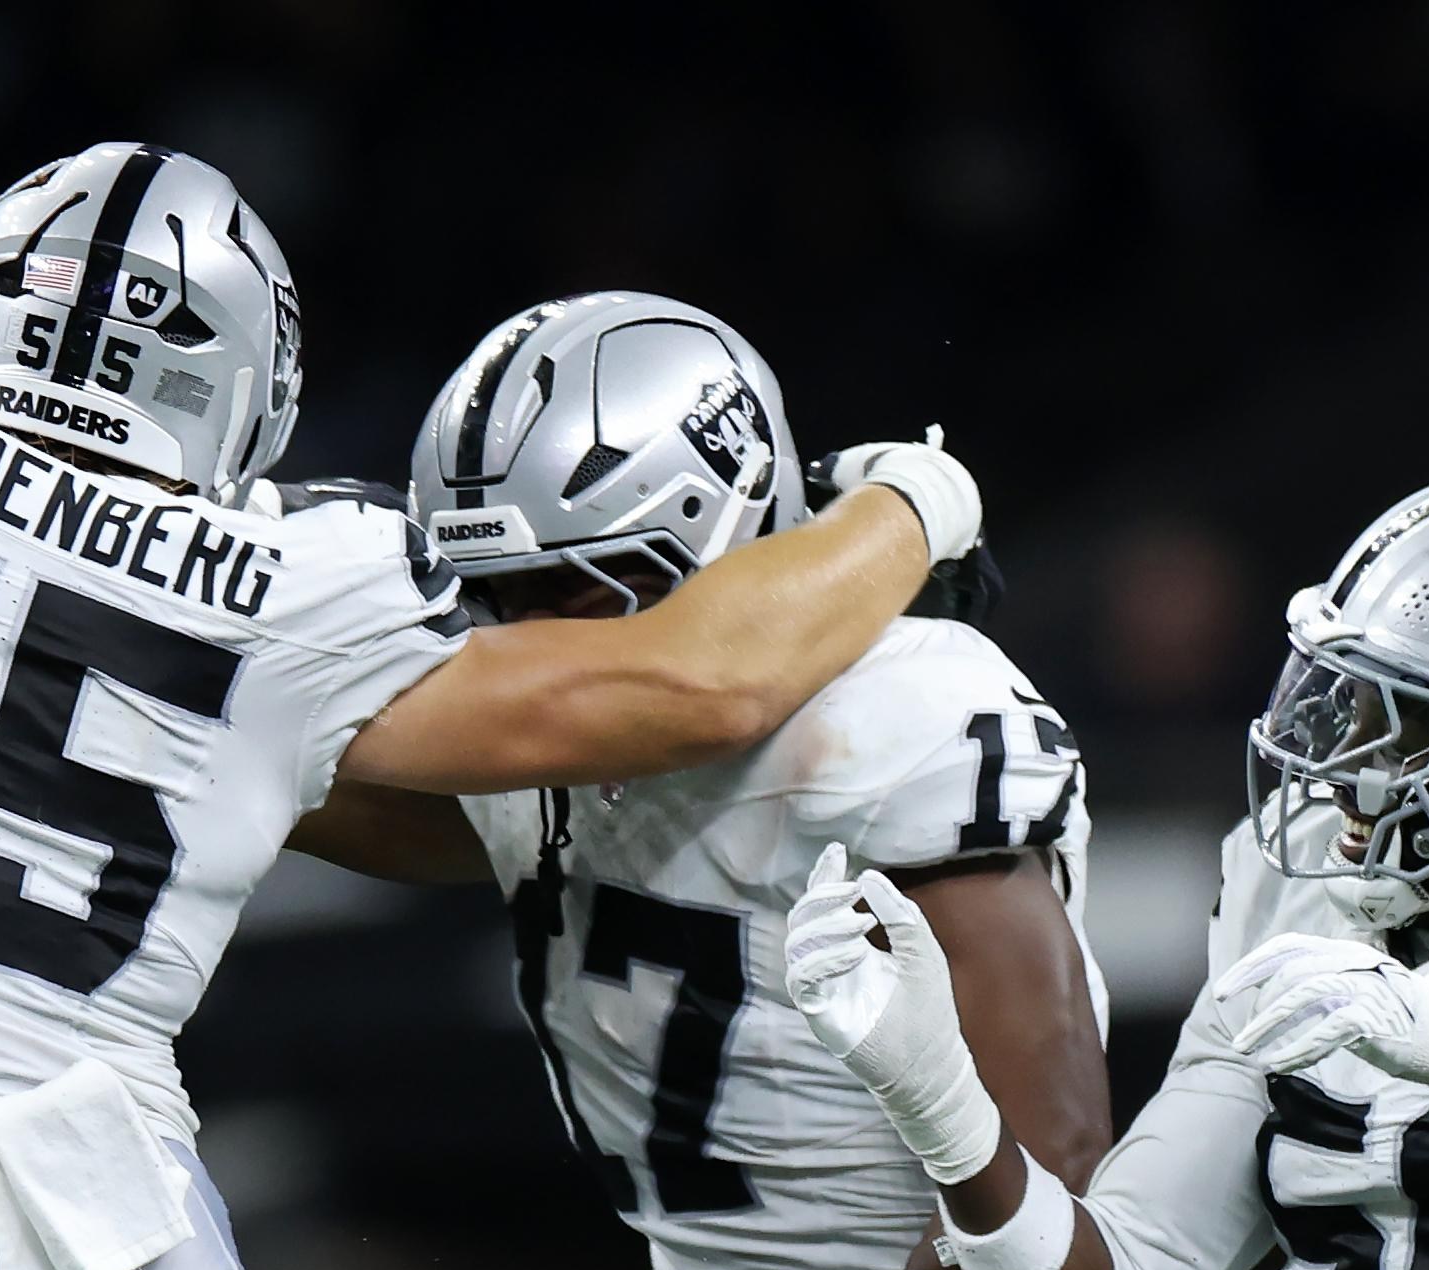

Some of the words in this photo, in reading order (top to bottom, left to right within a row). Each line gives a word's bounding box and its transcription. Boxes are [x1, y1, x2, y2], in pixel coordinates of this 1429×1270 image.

[128, 281, 160, 307] AL
[15, 312, 142, 396] 55
[436, 520, 505, 543] RAIDERS
